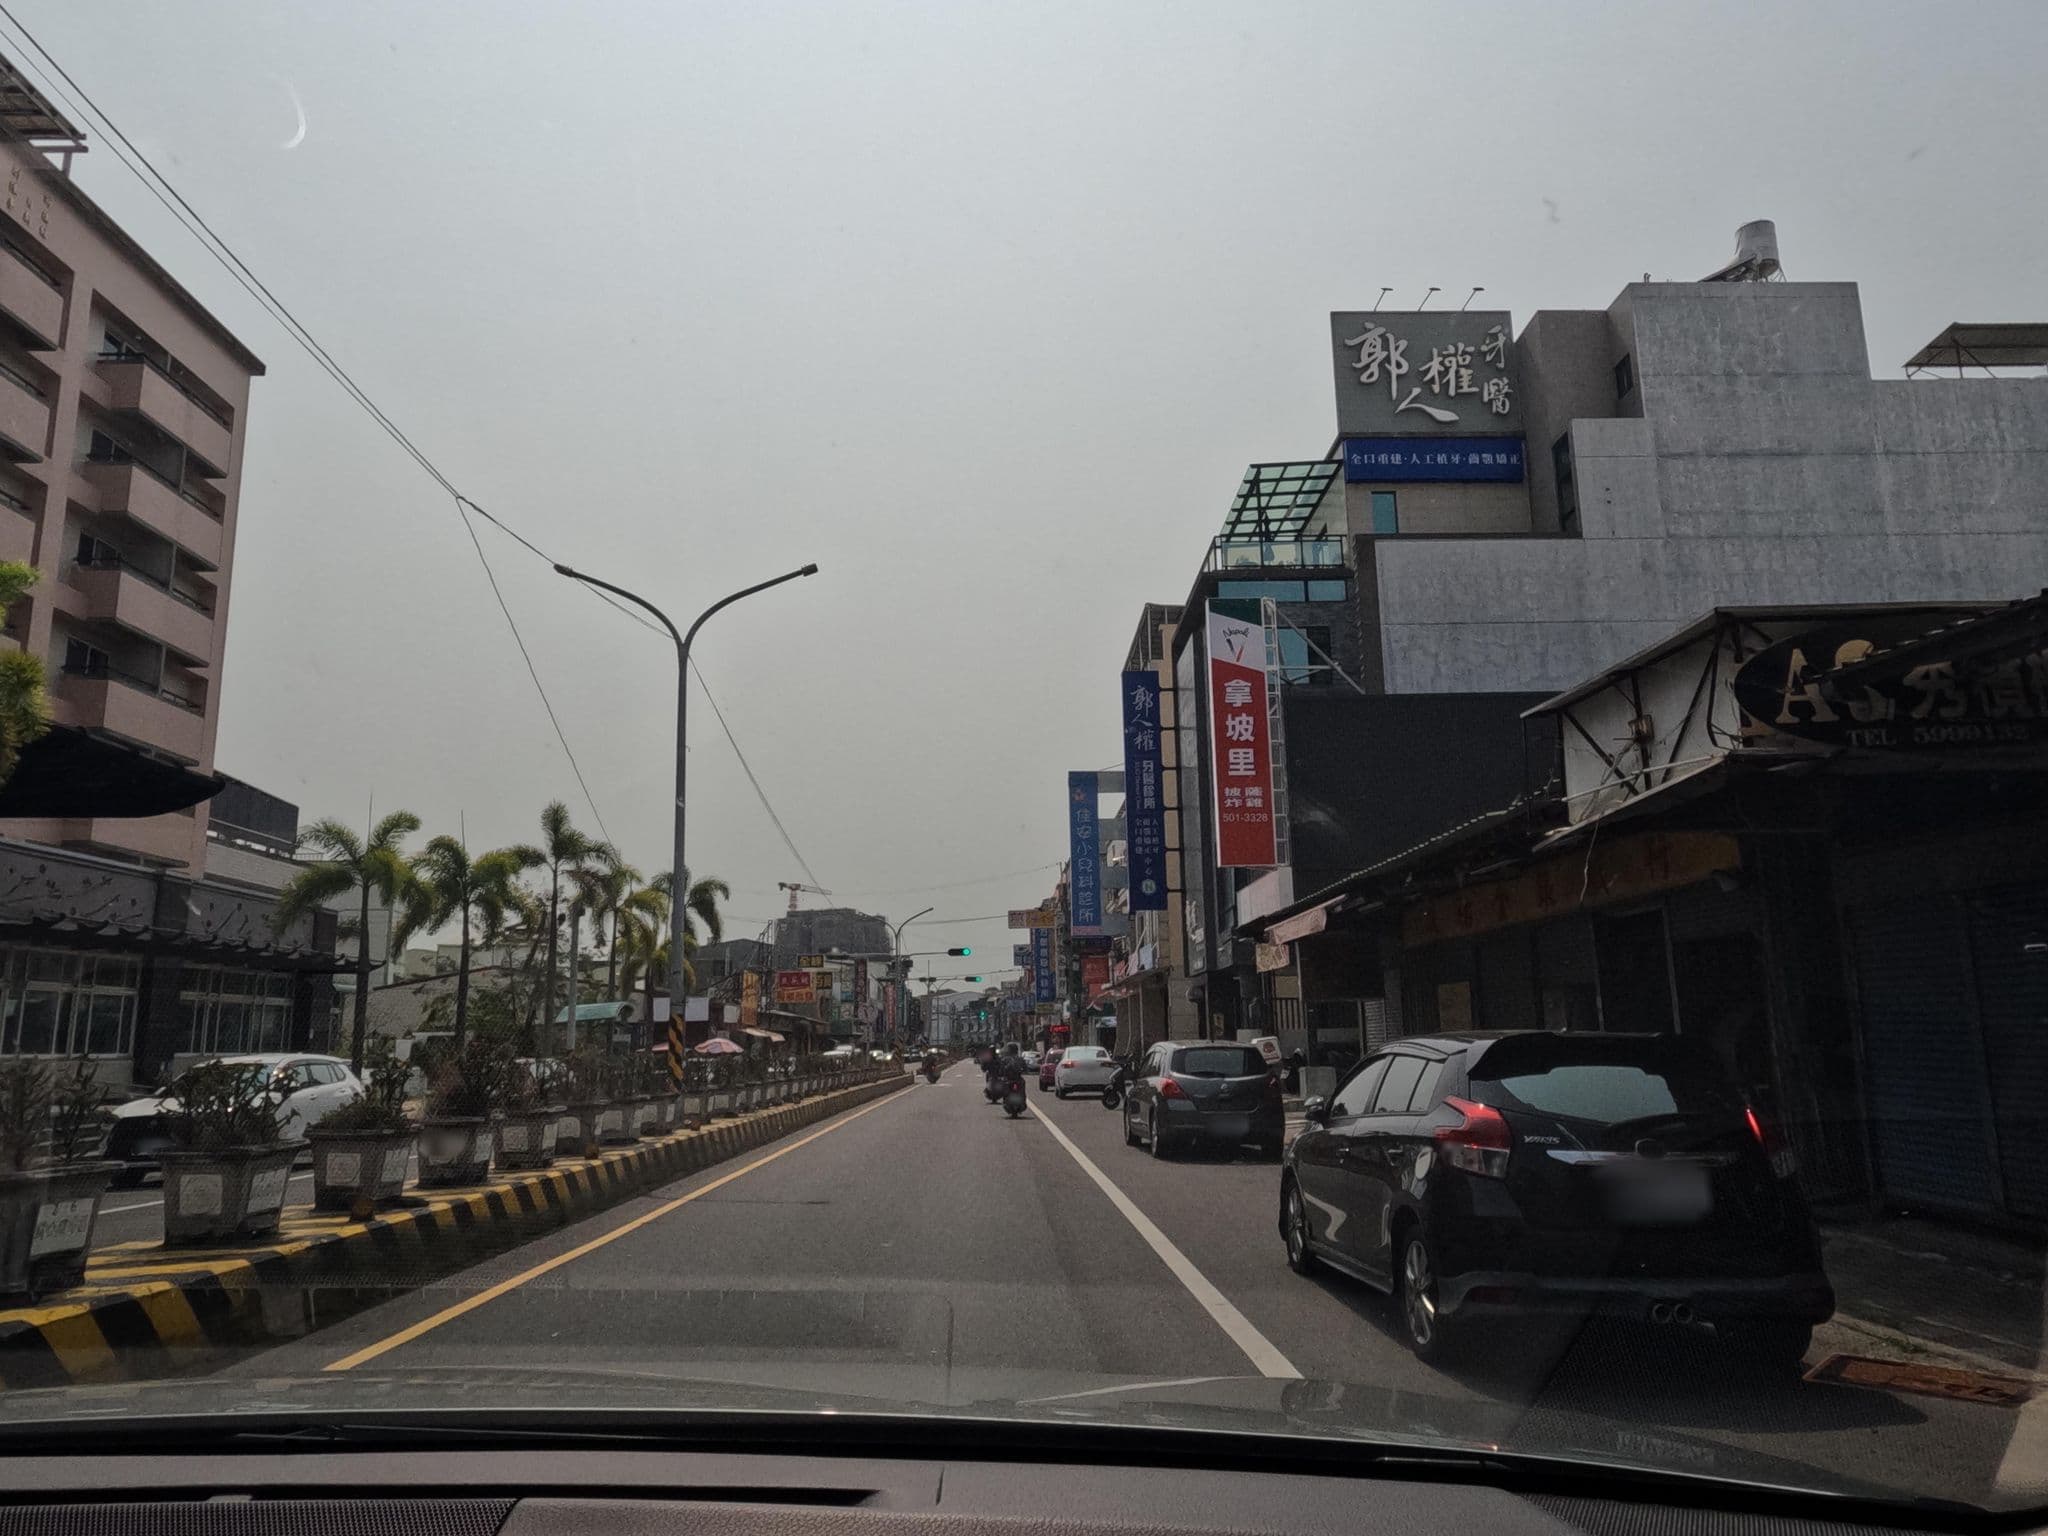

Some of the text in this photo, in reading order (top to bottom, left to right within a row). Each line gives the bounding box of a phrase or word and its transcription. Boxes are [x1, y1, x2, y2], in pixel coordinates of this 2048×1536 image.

[1224, 679, 1257, 777] 拿坡里
[1223, 813, 1268, 822] 501-3328
